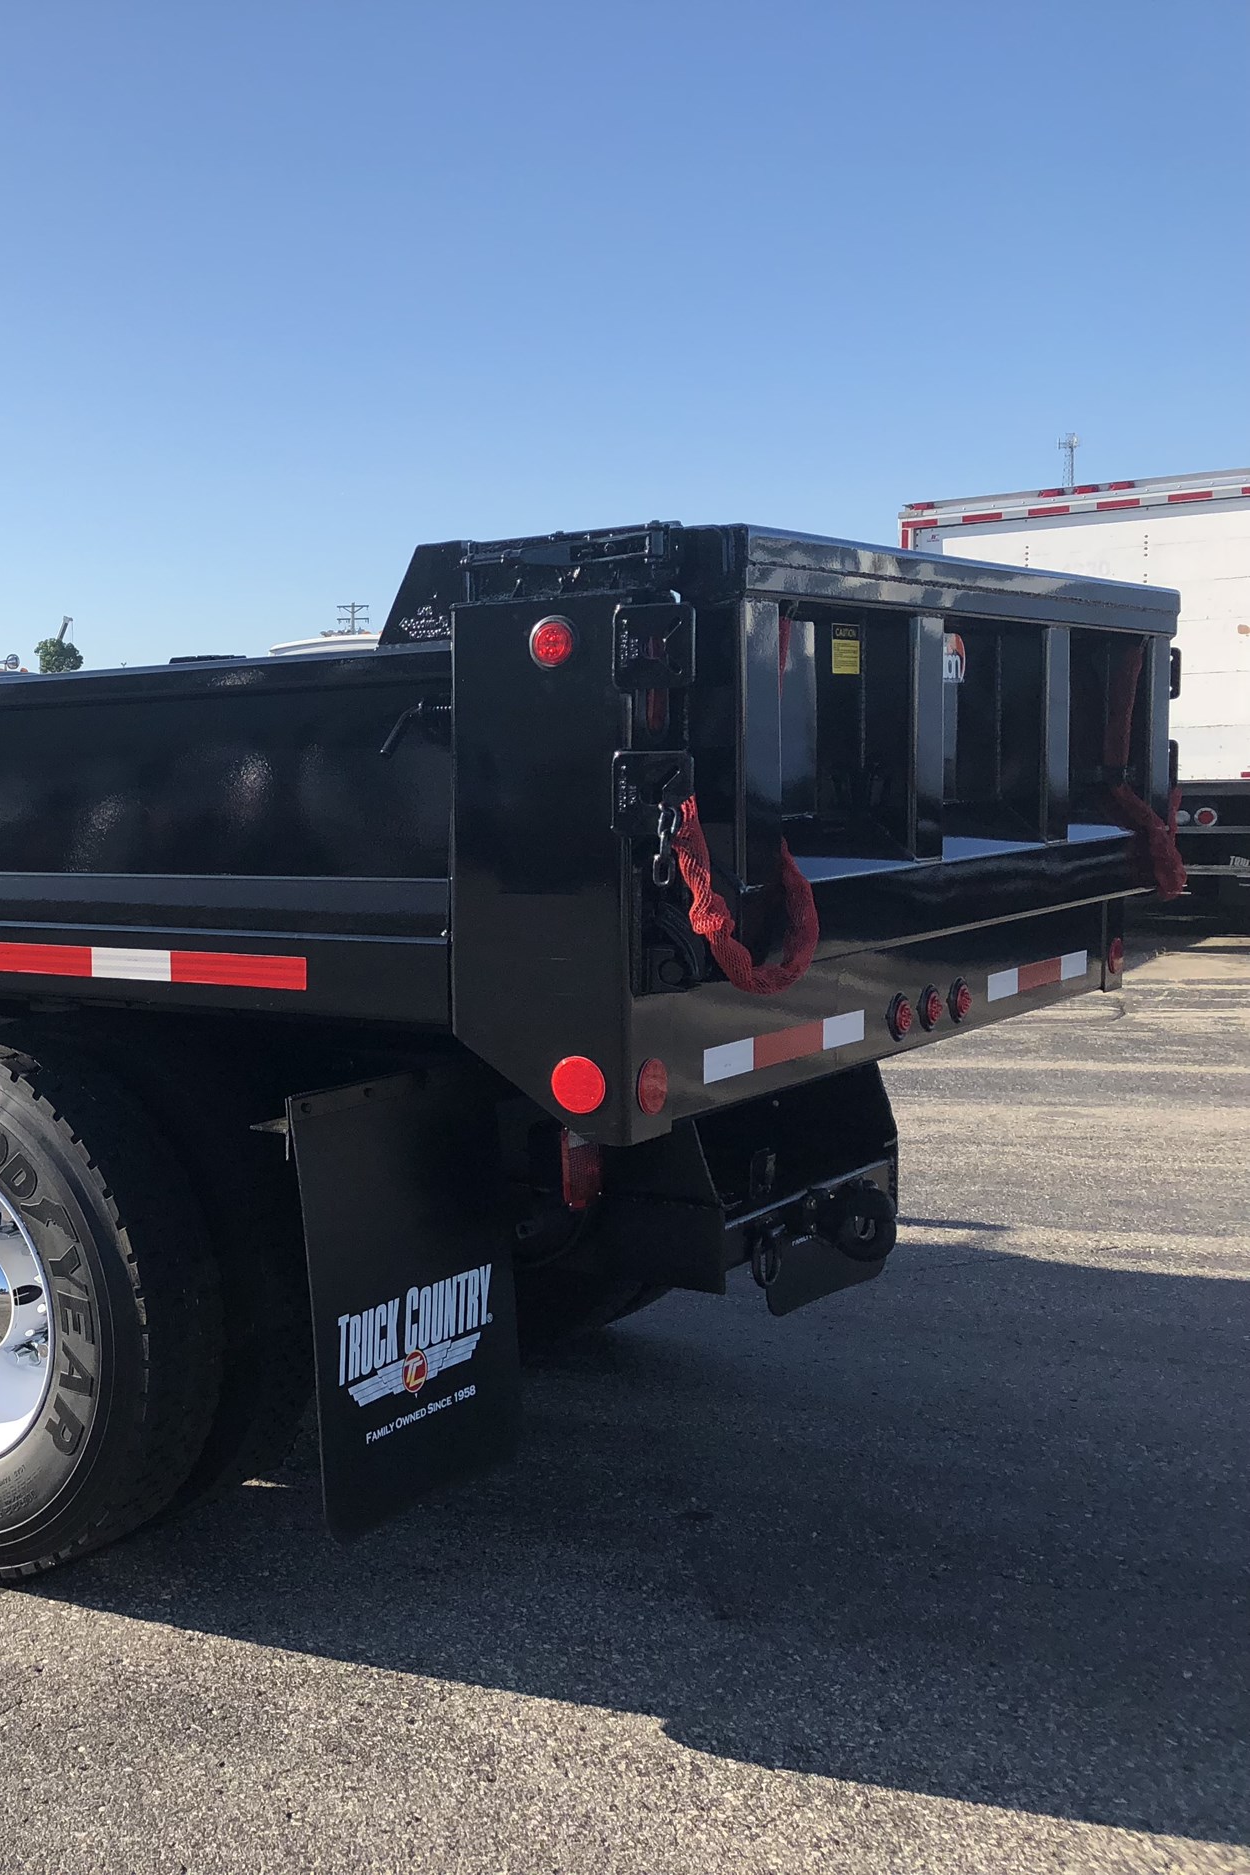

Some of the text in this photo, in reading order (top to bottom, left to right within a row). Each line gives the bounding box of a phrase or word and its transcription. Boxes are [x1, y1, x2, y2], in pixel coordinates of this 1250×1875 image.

[338, 1263, 492, 1387] TRUCK COUNTRY
[366, 1384, 476, 1444] FAMILY OWNED SINCE 1958
